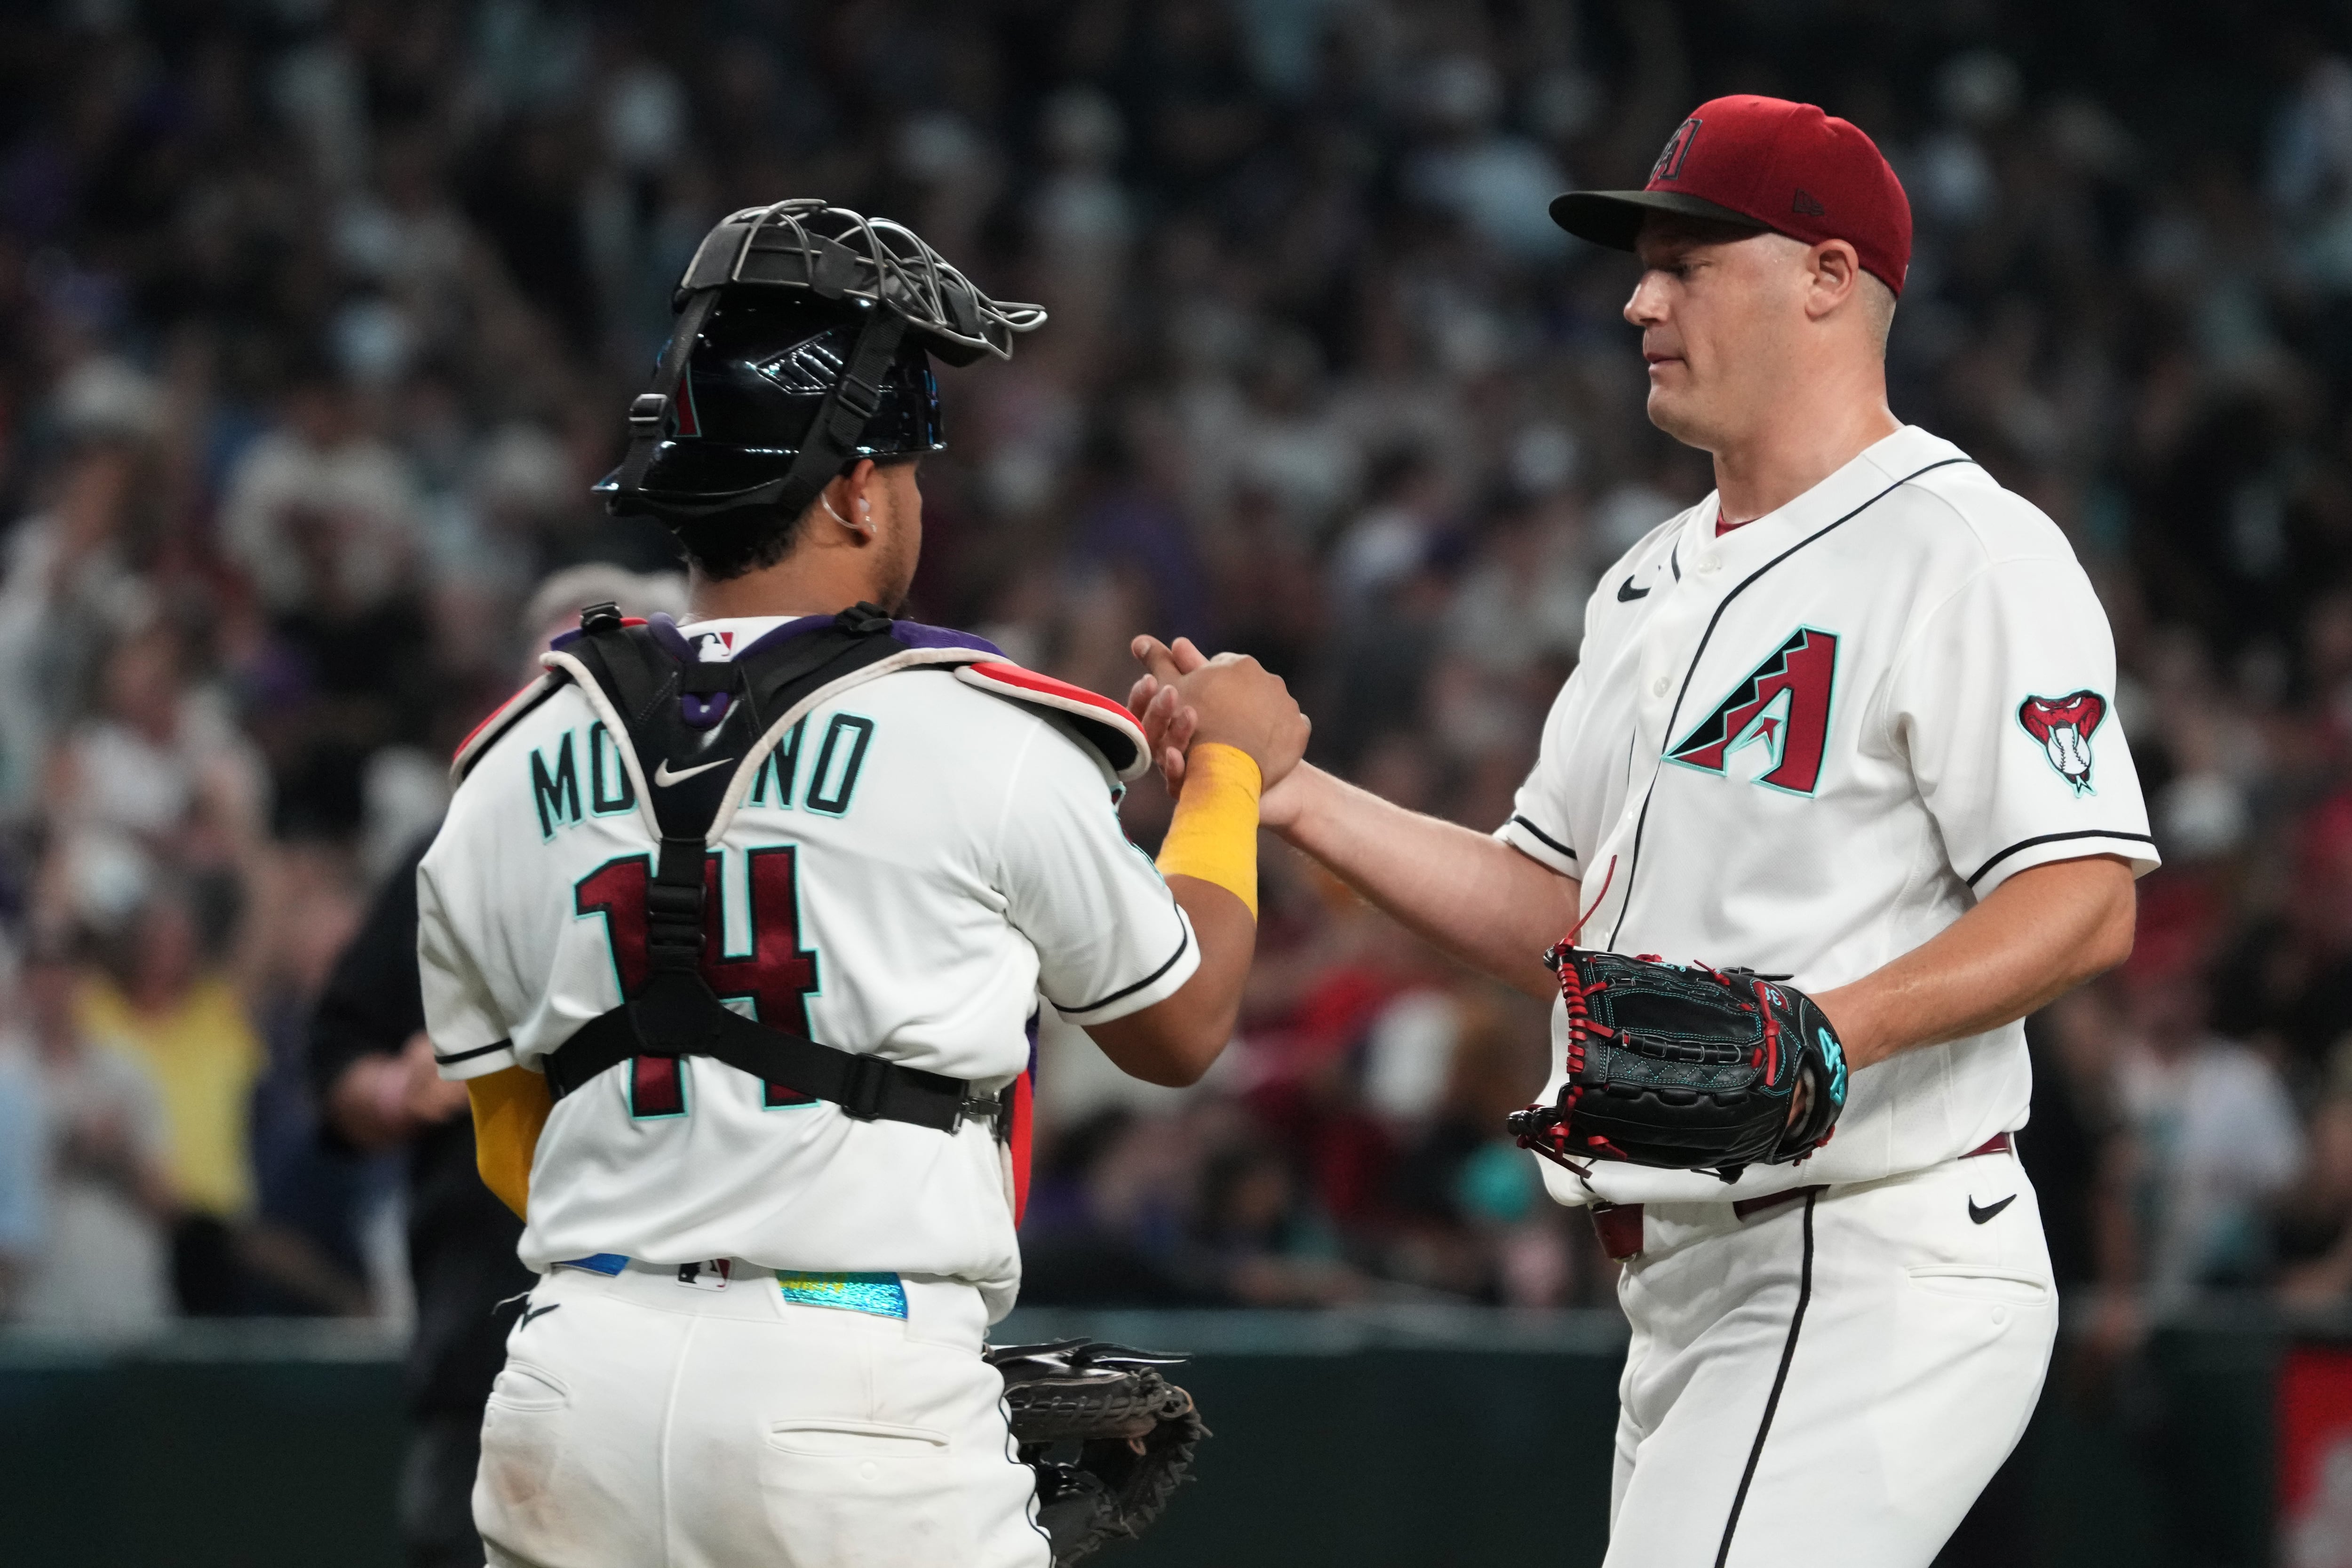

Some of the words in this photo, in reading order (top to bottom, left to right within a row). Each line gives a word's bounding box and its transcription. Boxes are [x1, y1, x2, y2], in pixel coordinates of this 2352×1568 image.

[529, 709, 877, 845] MONO
[1660, 623, 1841, 799] A
[573, 843, 822, 1121] 14
